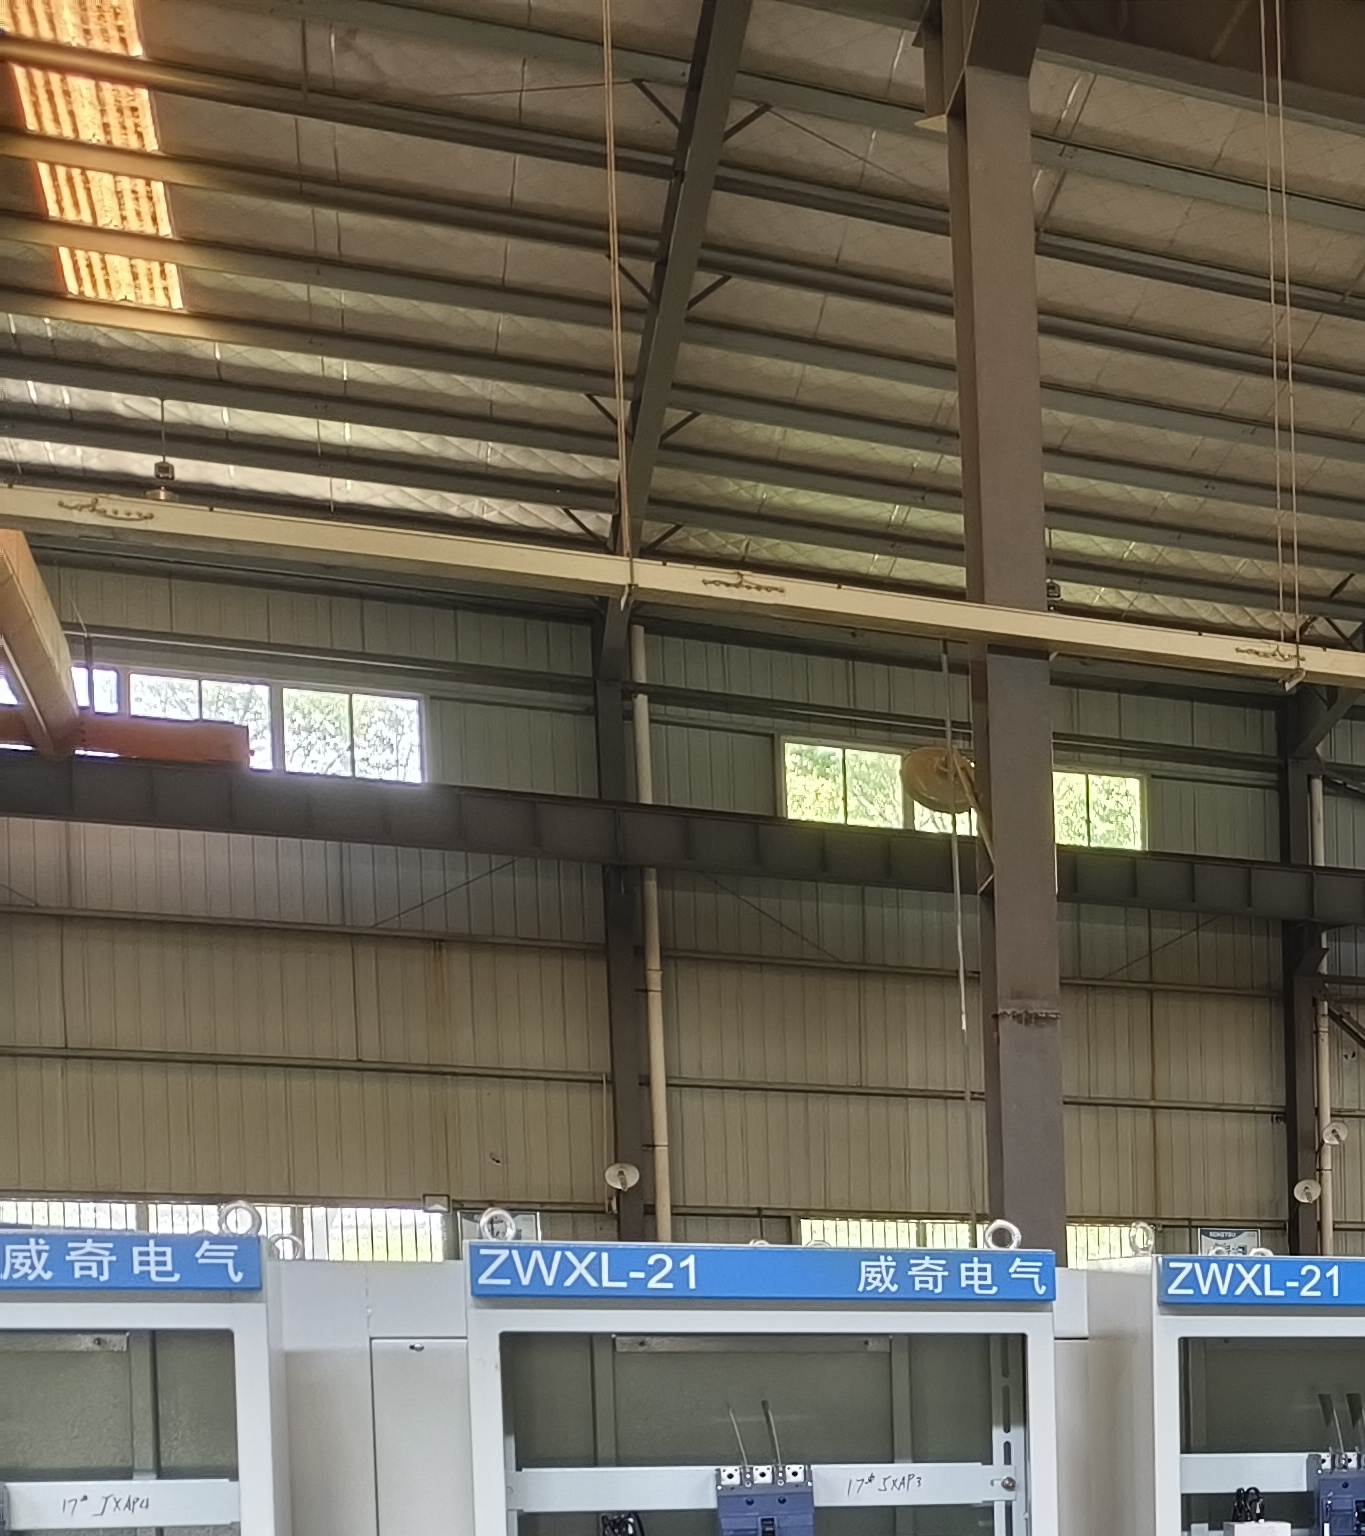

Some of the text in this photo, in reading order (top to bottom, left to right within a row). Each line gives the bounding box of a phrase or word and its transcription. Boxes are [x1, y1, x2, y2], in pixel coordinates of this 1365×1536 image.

[3, 1238, 243, 1283] 威奇电气
[478, 1249, 697, 1290] ZWXL-21
[857, 1256, 1047, 1296] 威奇电气
[1167, 1262, 1340, 1297] ZWXL-21
